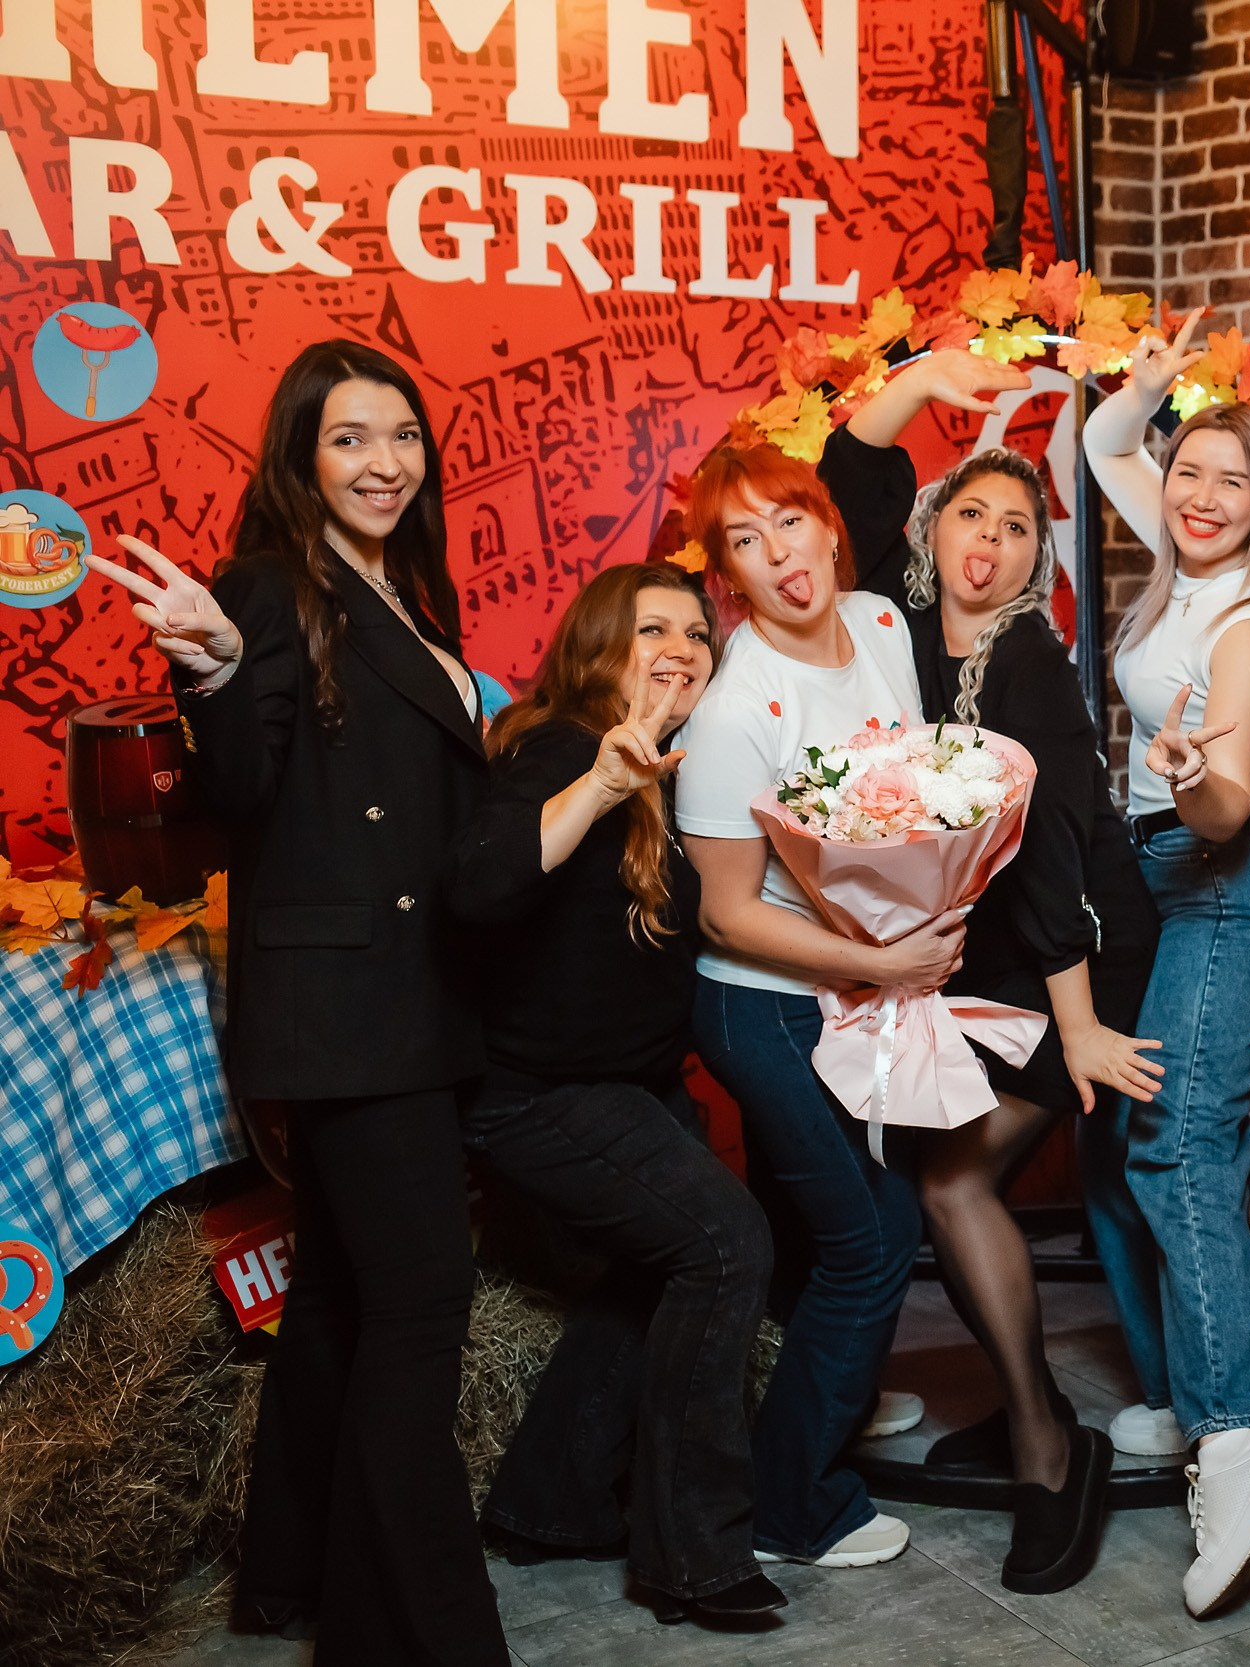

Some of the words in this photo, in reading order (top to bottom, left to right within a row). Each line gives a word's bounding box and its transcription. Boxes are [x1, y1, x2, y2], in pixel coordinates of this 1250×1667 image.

[226, 156, 353, 277] &
[386, 165, 860, 304] GRILL
[225, 1232, 296, 1310] HE
